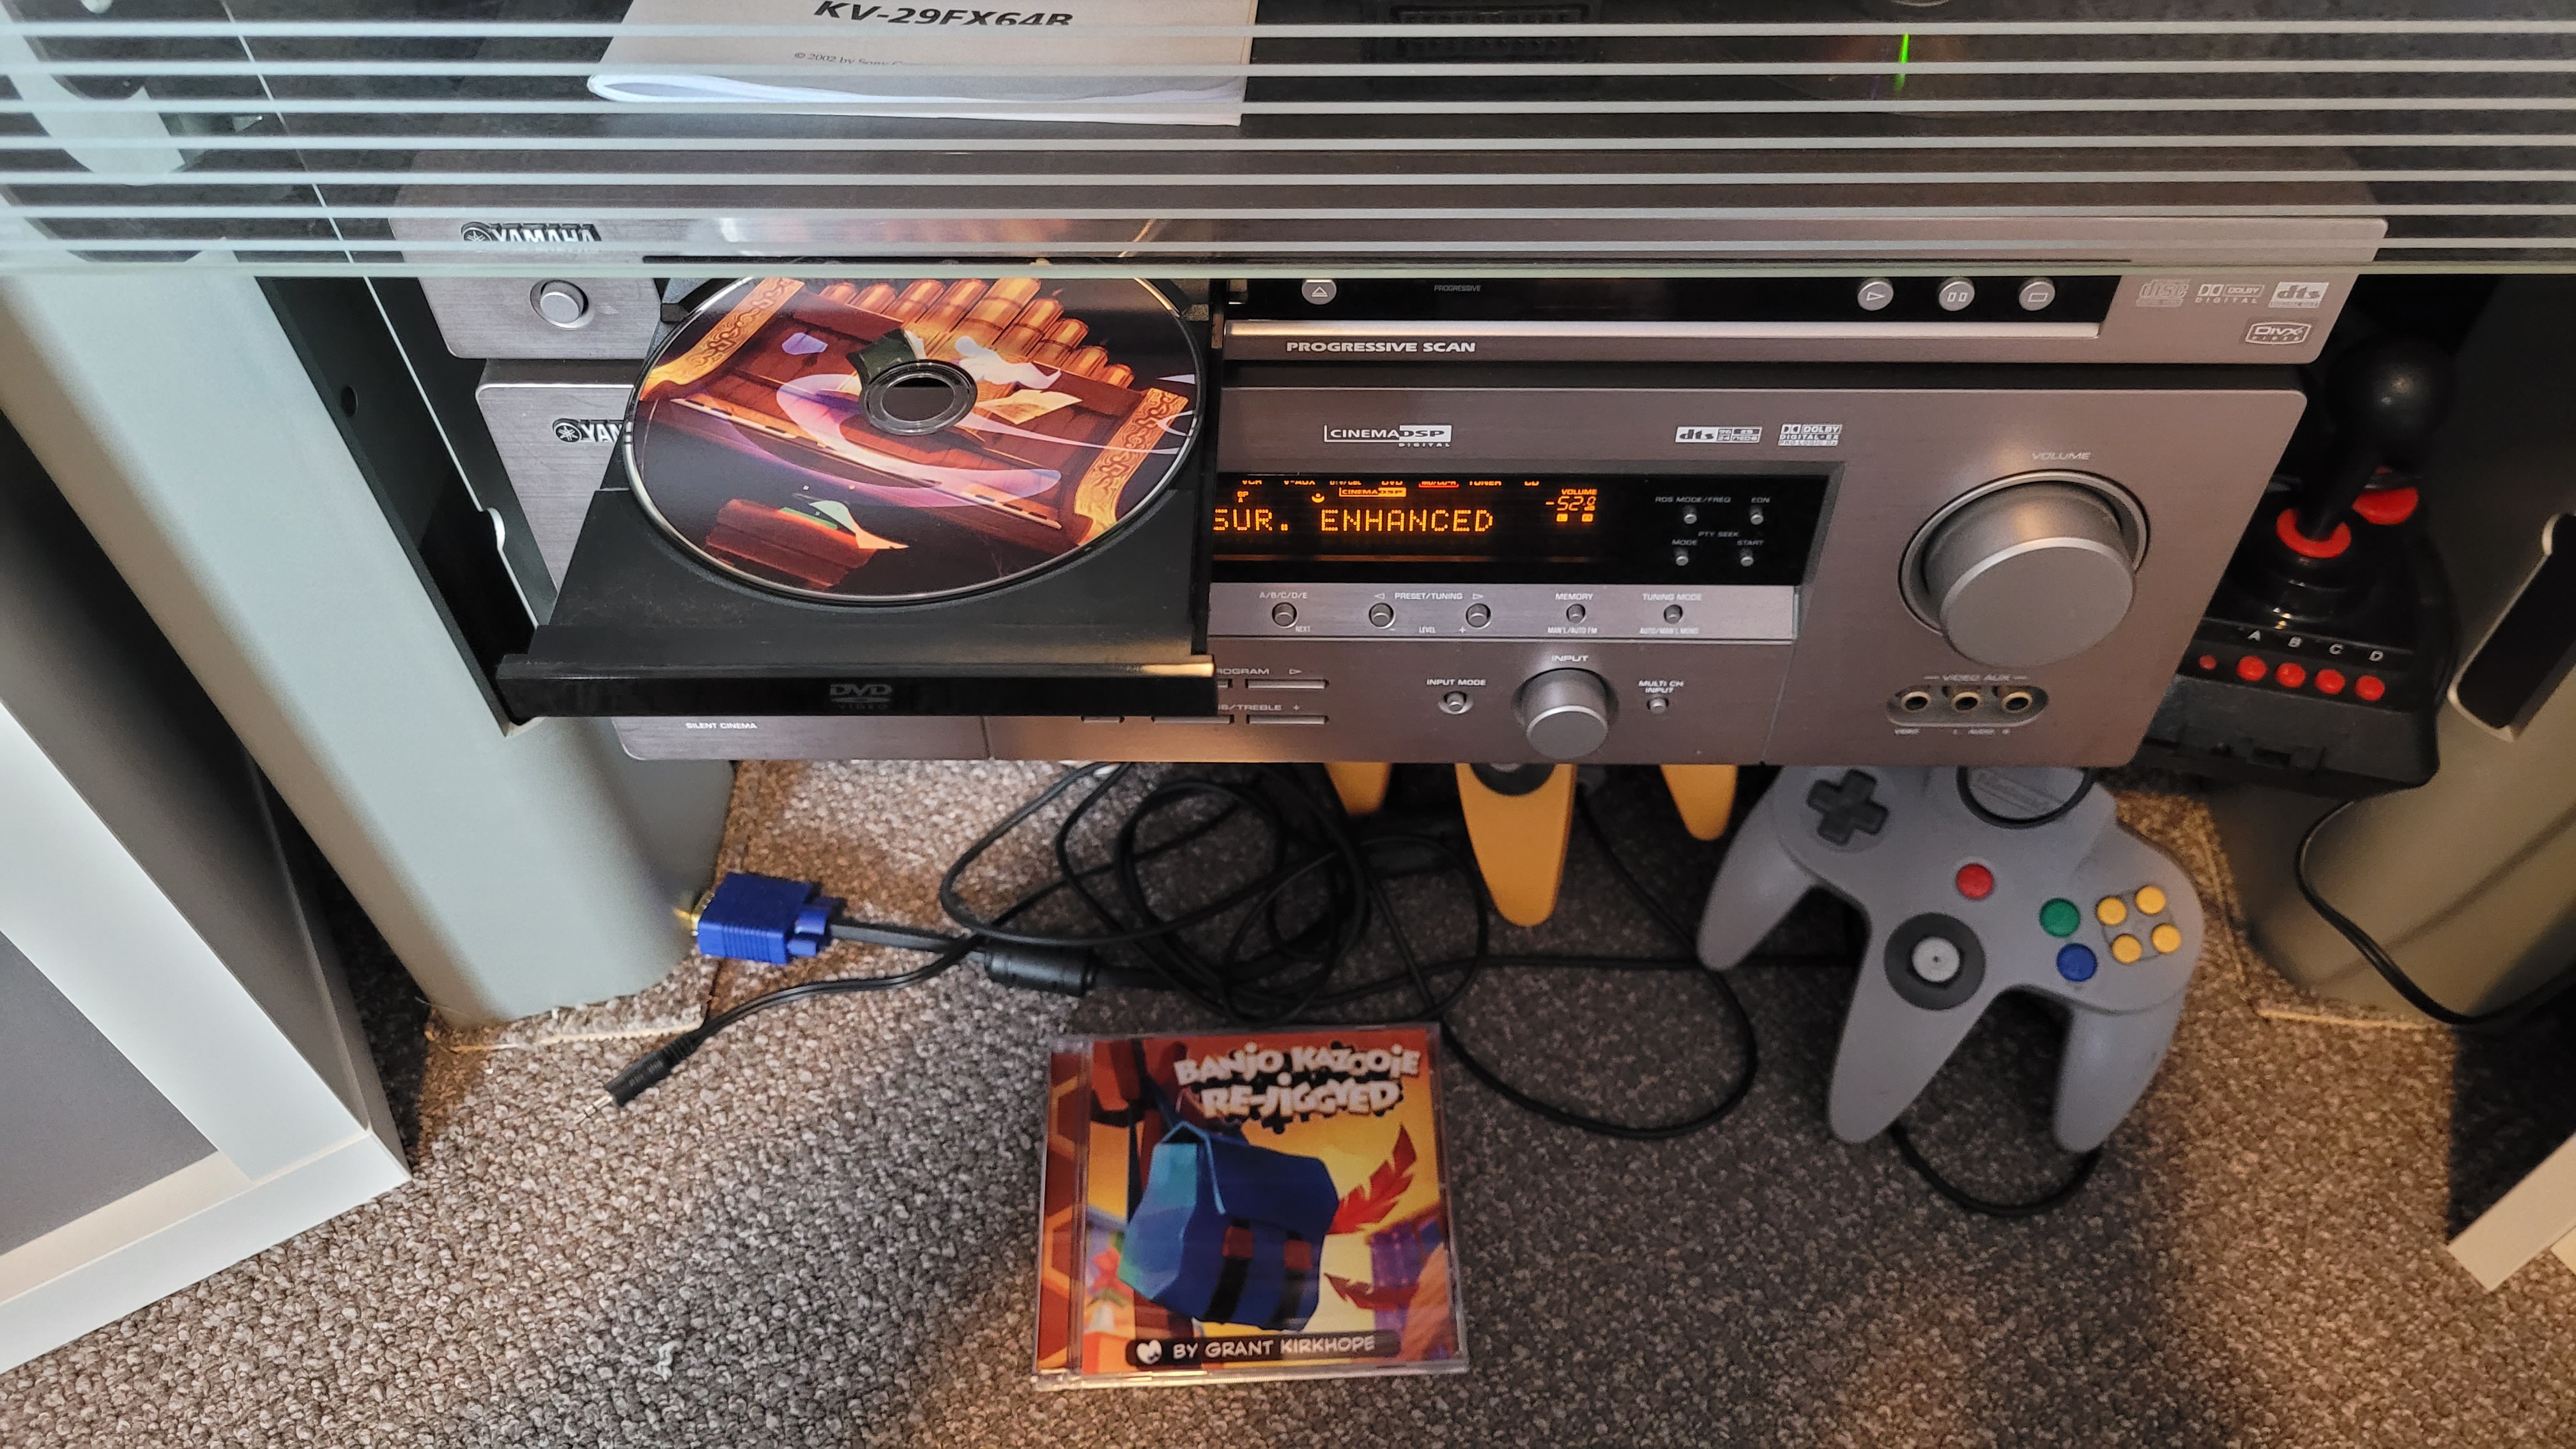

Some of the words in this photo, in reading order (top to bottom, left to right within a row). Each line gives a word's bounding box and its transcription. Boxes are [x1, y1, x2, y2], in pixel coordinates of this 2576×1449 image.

[807, 53, 836, 63] 2002
[490, 227, 598, 242] YAMAHA
[2276, 284, 2321, 300] dts
[1286, 342, 1418, 352] PROGRESSIVE
[1422, 342, 1476, 352] SCAN
[579, 422, 624, 443] YAM
[1679, 429, 1715, 440] dts
[2032, 452, 2091, 460] VOLUME
[1213, 509, 1289, 532] SUR.
[1321, 509, 1494, 532] ENHANCED
[2248, 630, 2261, 641] A
[2287, 636, 2302, 648] B
[2329, 643, 2345, 655] C
[2368, 650, 2384, 662] D
[830, 684, 893, 696] DVD
[1172, 1343, 1199, 1360] BY
[1204, 1339, 1275, 1359] GRANT
[1280, 1335, 1377, 1355] KIRKHOPE
